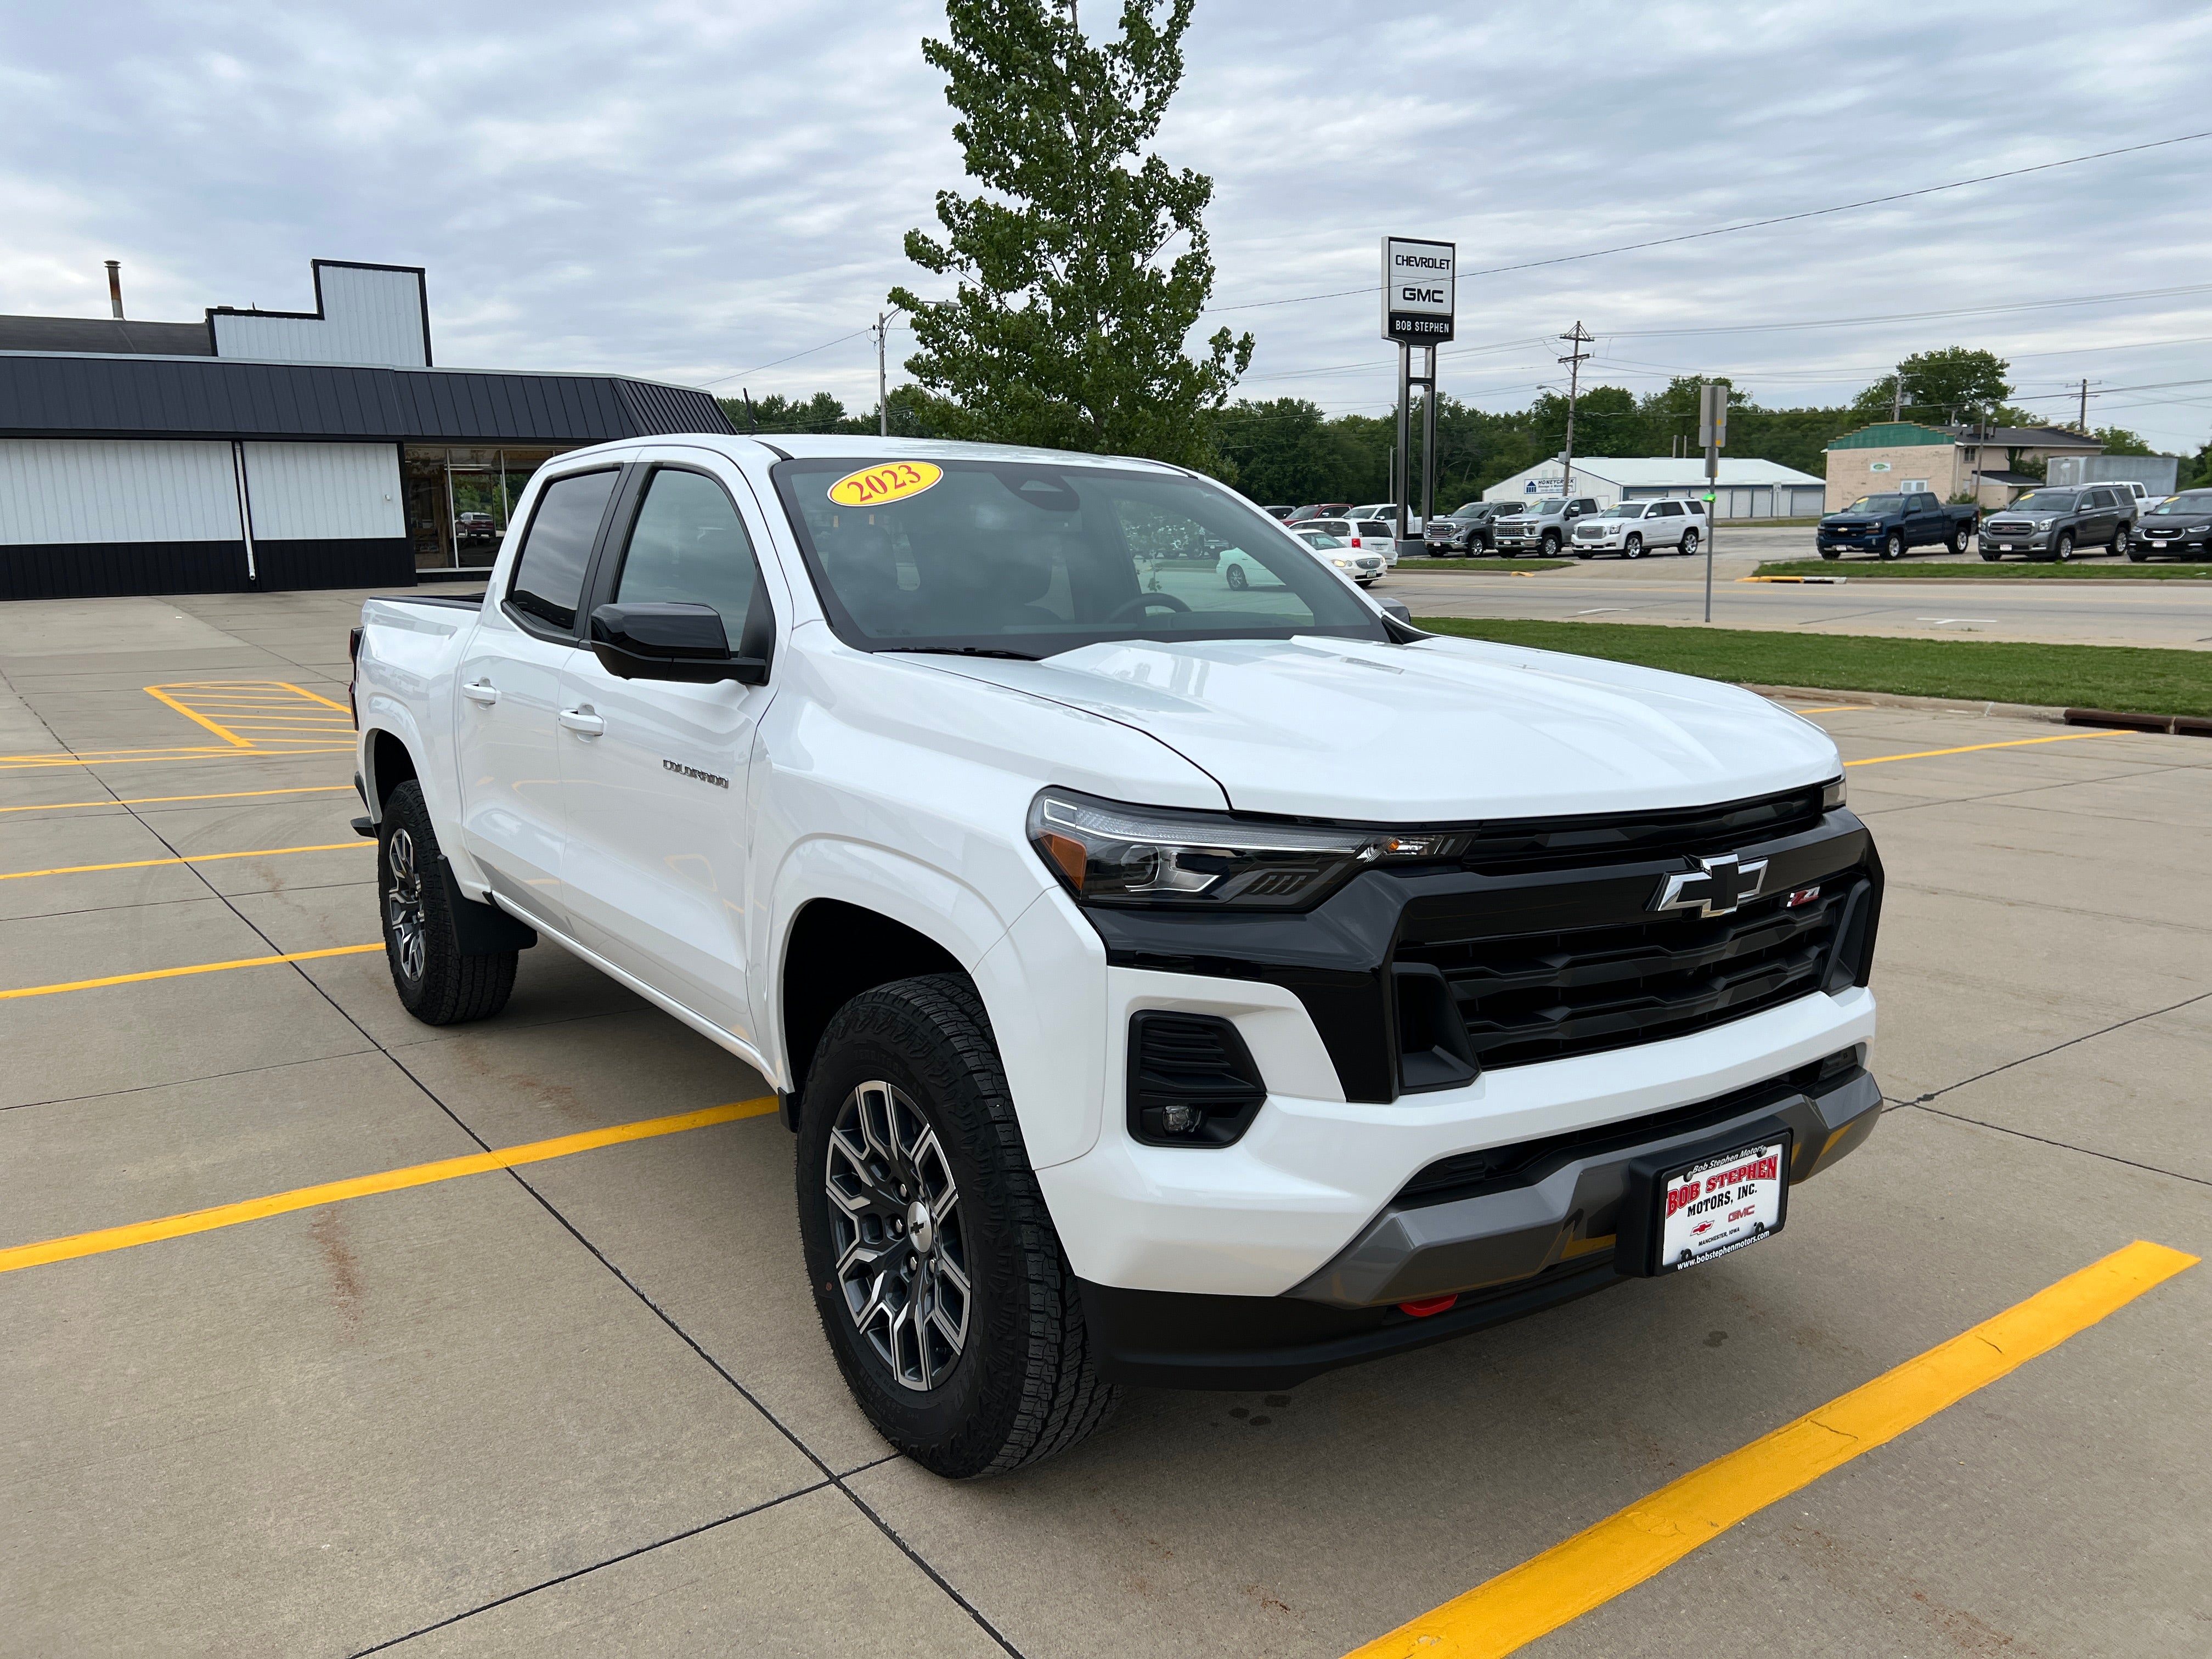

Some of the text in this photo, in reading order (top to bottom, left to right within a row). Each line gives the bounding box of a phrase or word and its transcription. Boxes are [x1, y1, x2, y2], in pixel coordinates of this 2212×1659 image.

[1395, 254, 1451, 270] CHEVROLET
[1402, 287, 1444, 303] GMC
[1395, 320, 1449, 333] BOB STEPHEN
[847, 465, 921, 502] 2023
[1692, 1145, 1764, 1173] Bob Stephen Motors
[1666, 1154, 1778, 1219] BOB STEPHEN
[1687, 1183, 1758, 1217] MOTORS, INC.
[1728, 1204, 1756, 1222] GMC
[1698, 1227, 1740, 1247] MANCHESTER, IOWA
[1677, 1230, 1770, 1271] www.bobstephenmotors.com
